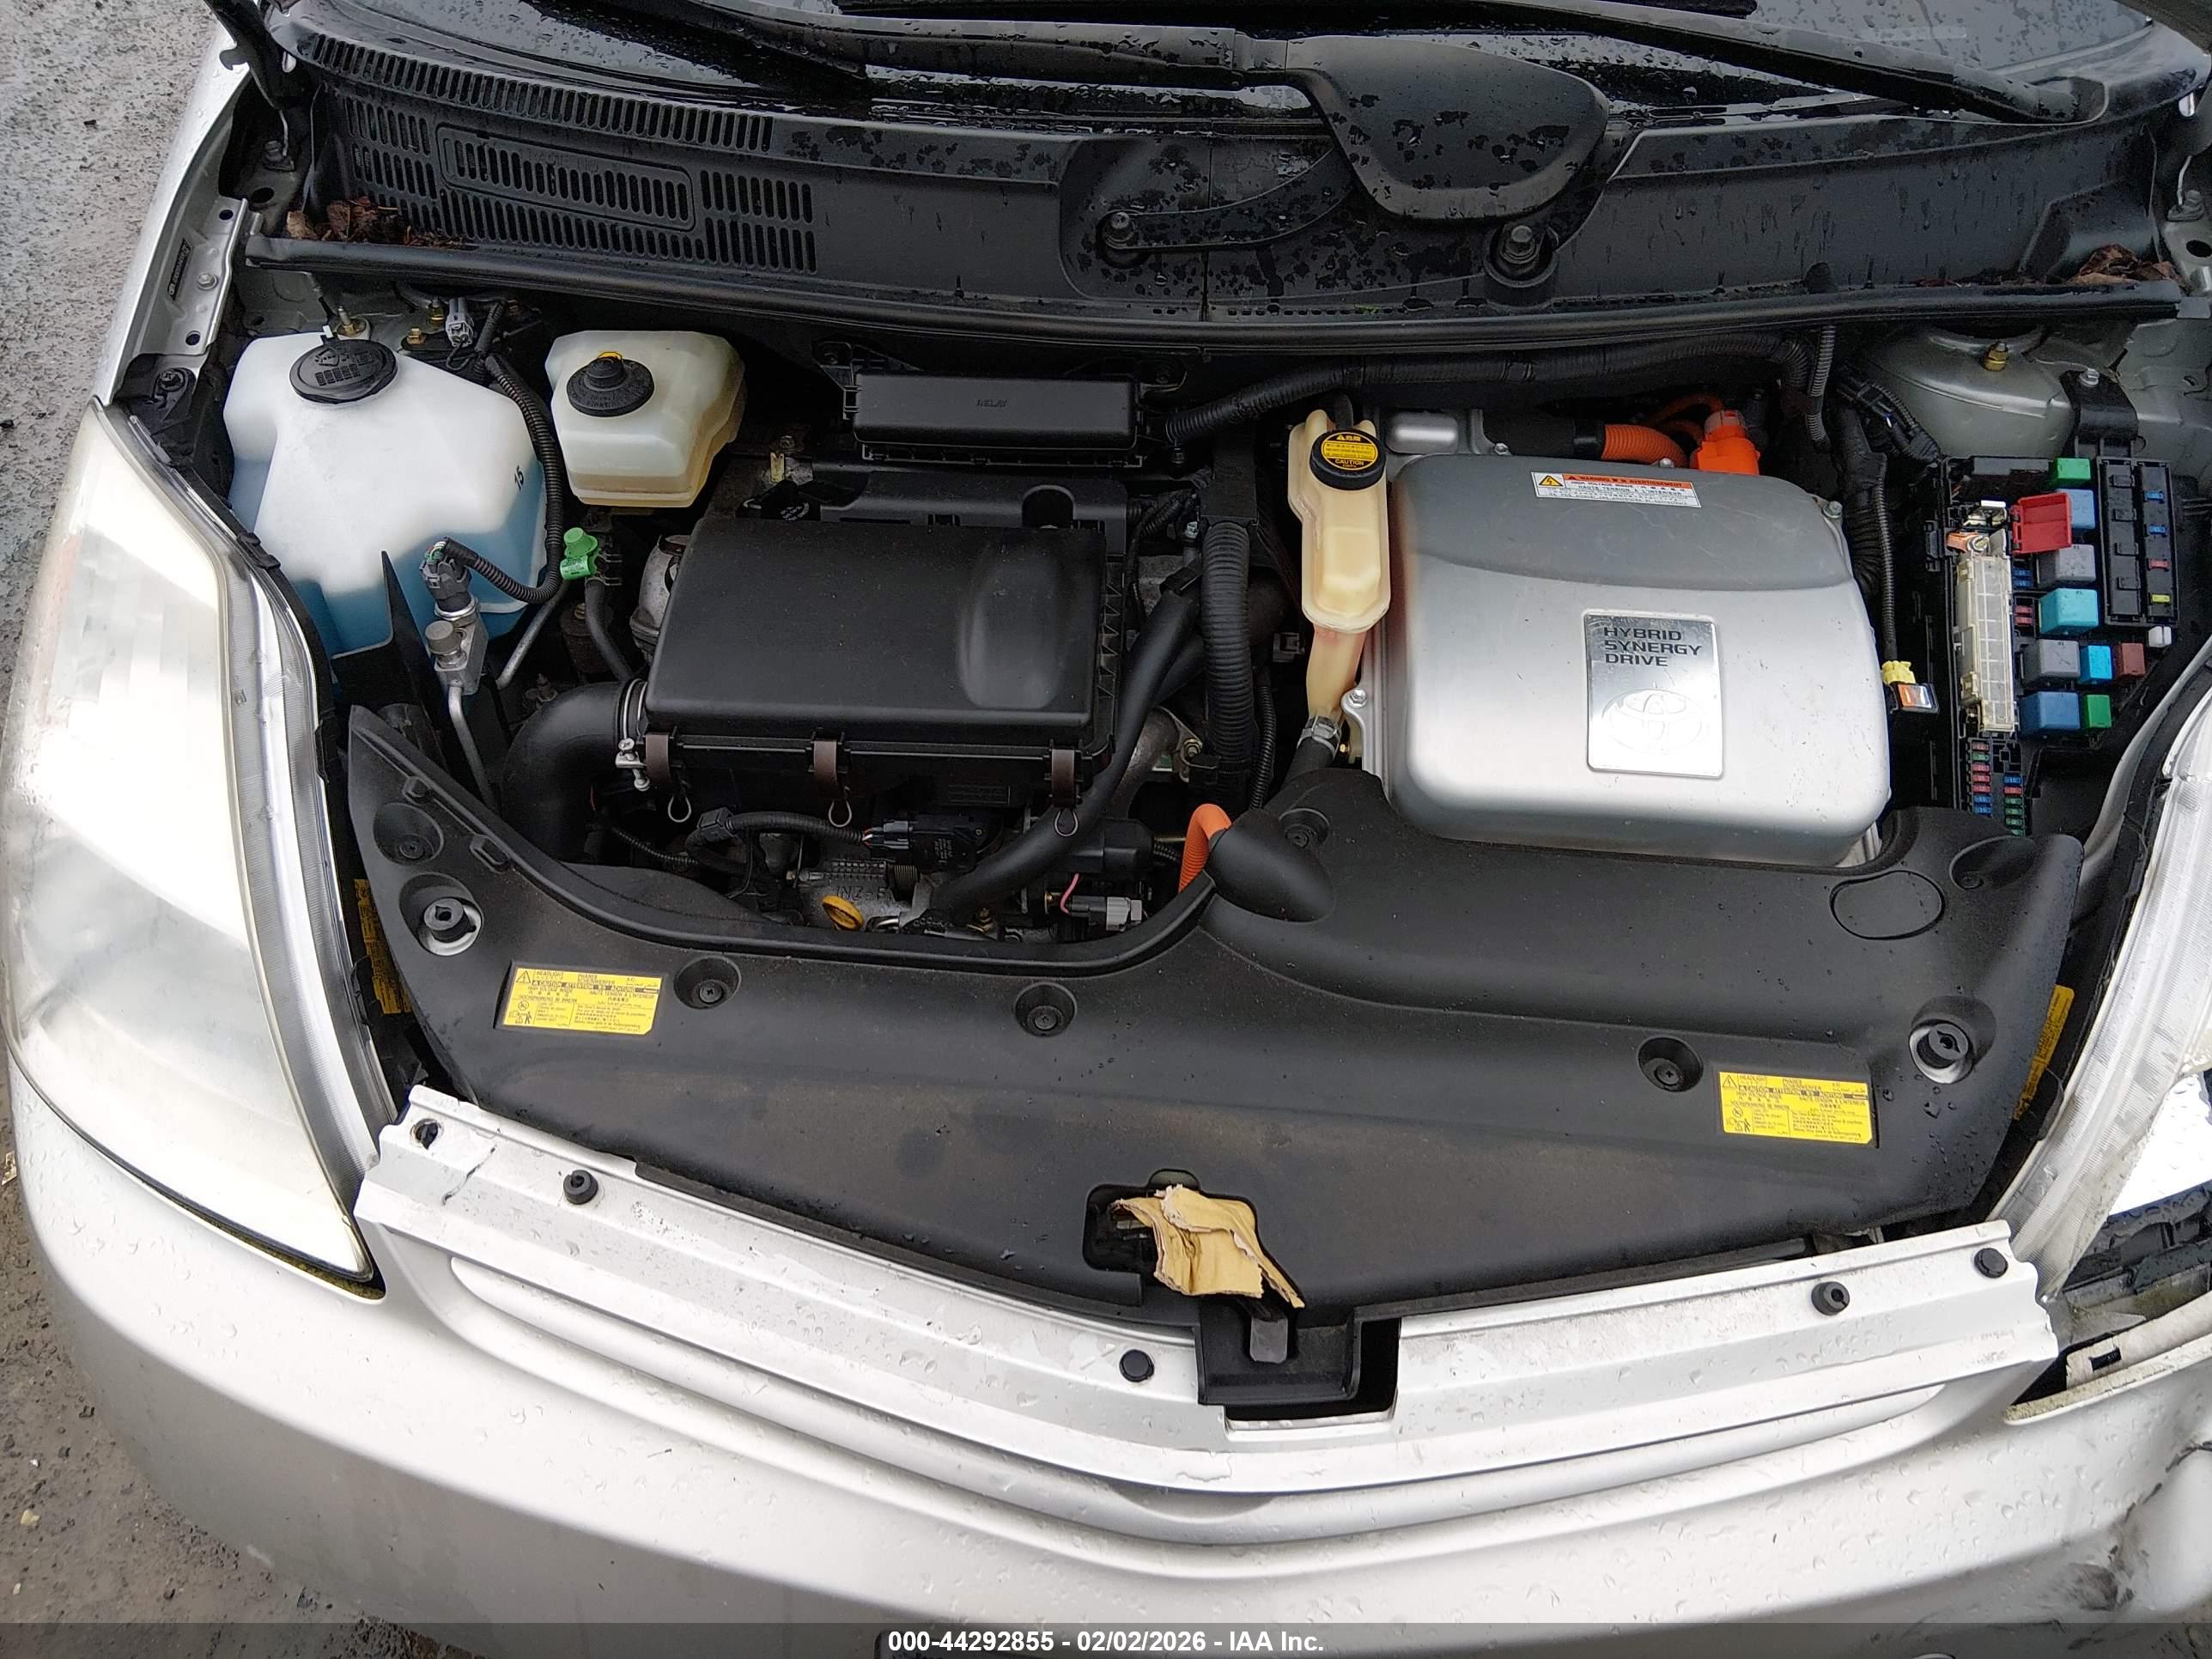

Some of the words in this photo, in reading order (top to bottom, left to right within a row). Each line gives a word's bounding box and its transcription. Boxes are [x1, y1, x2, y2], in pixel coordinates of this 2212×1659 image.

[1604, 627, 1682, 641] HYBRID
[1604, 640, 1702, 656] SYNERGY
[1605, 653, 1668, 667] DRIVE
